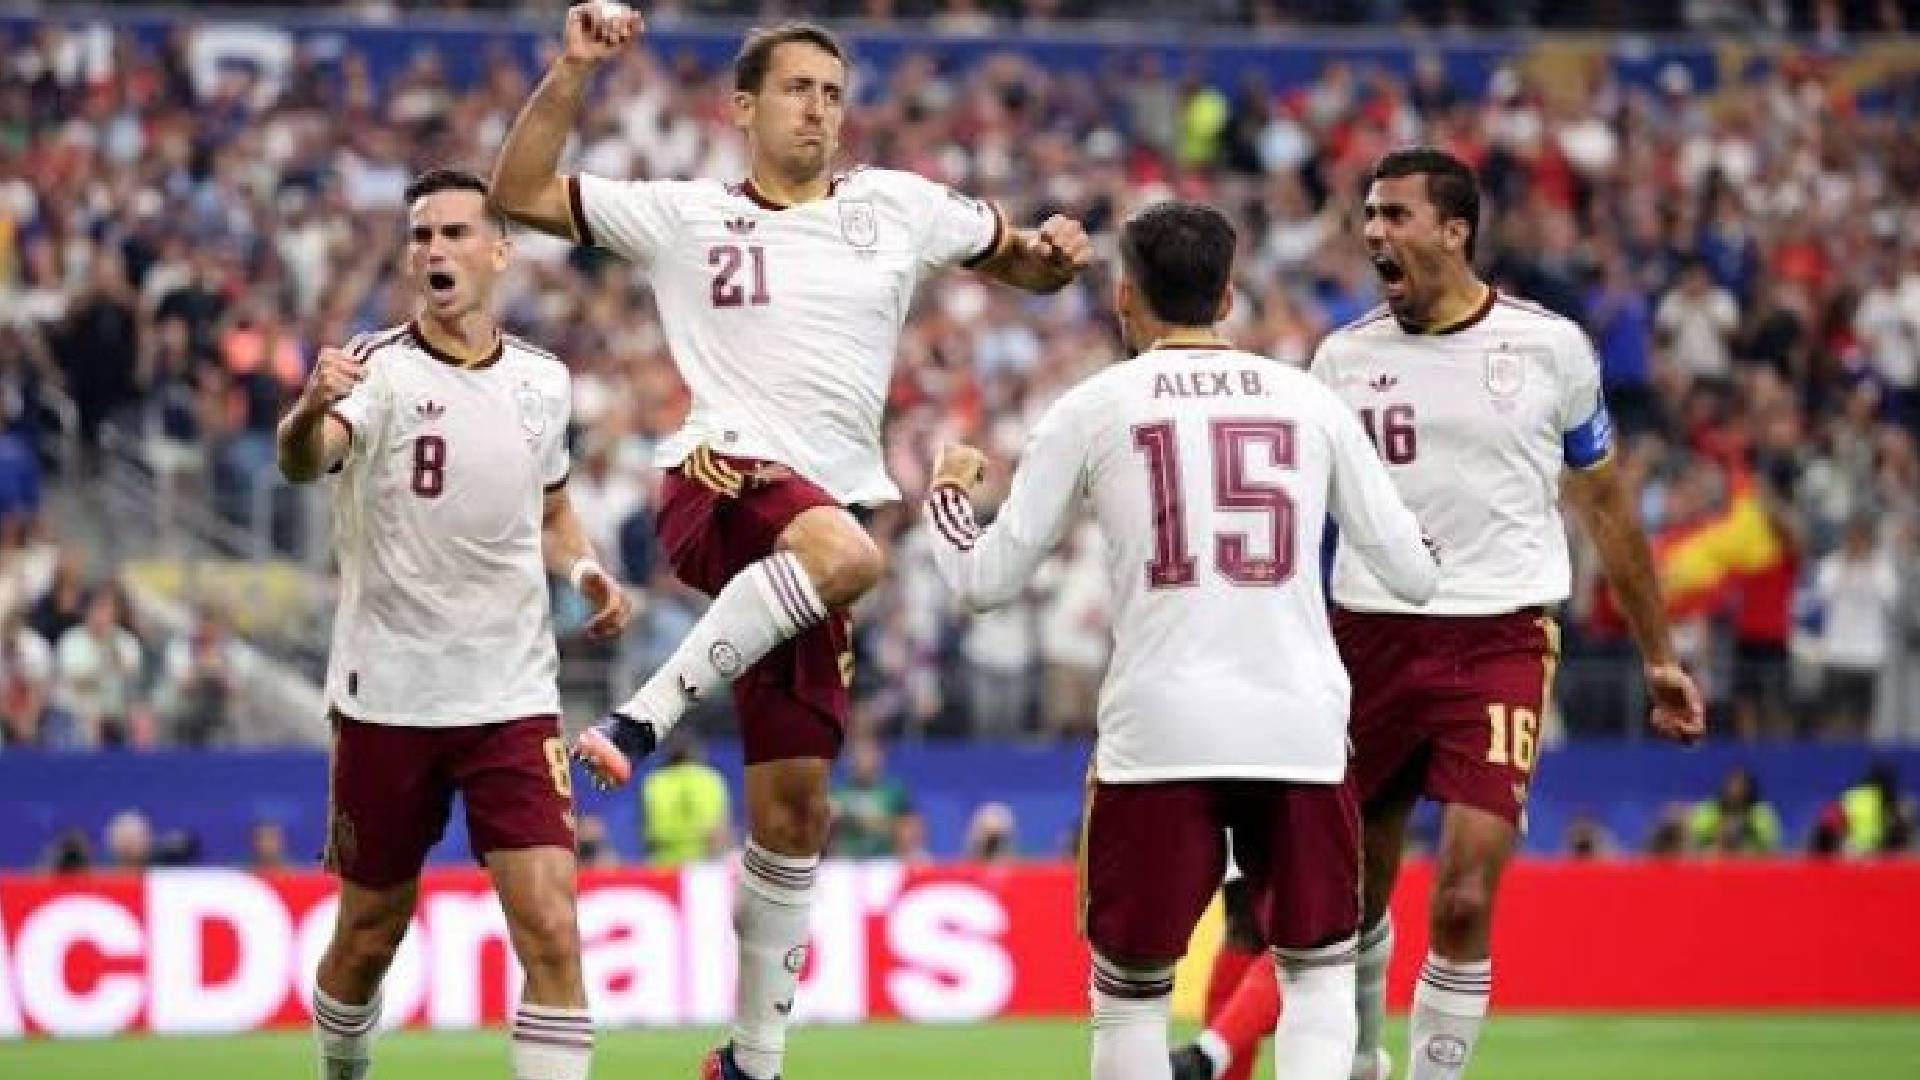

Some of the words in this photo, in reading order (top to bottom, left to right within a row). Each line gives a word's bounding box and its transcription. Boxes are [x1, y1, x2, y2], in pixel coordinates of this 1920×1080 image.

[708, 246, 771, 308] 21
[1154, 370, 1233, 398] ALEX
[1241, 369, 1273, 396] B.
[412, 436, 447, 498] 8
[1131, 416, 1298, 590] 15
[543, 737, 572, 797] 8
[1485, 703, 1537, 771] 16
